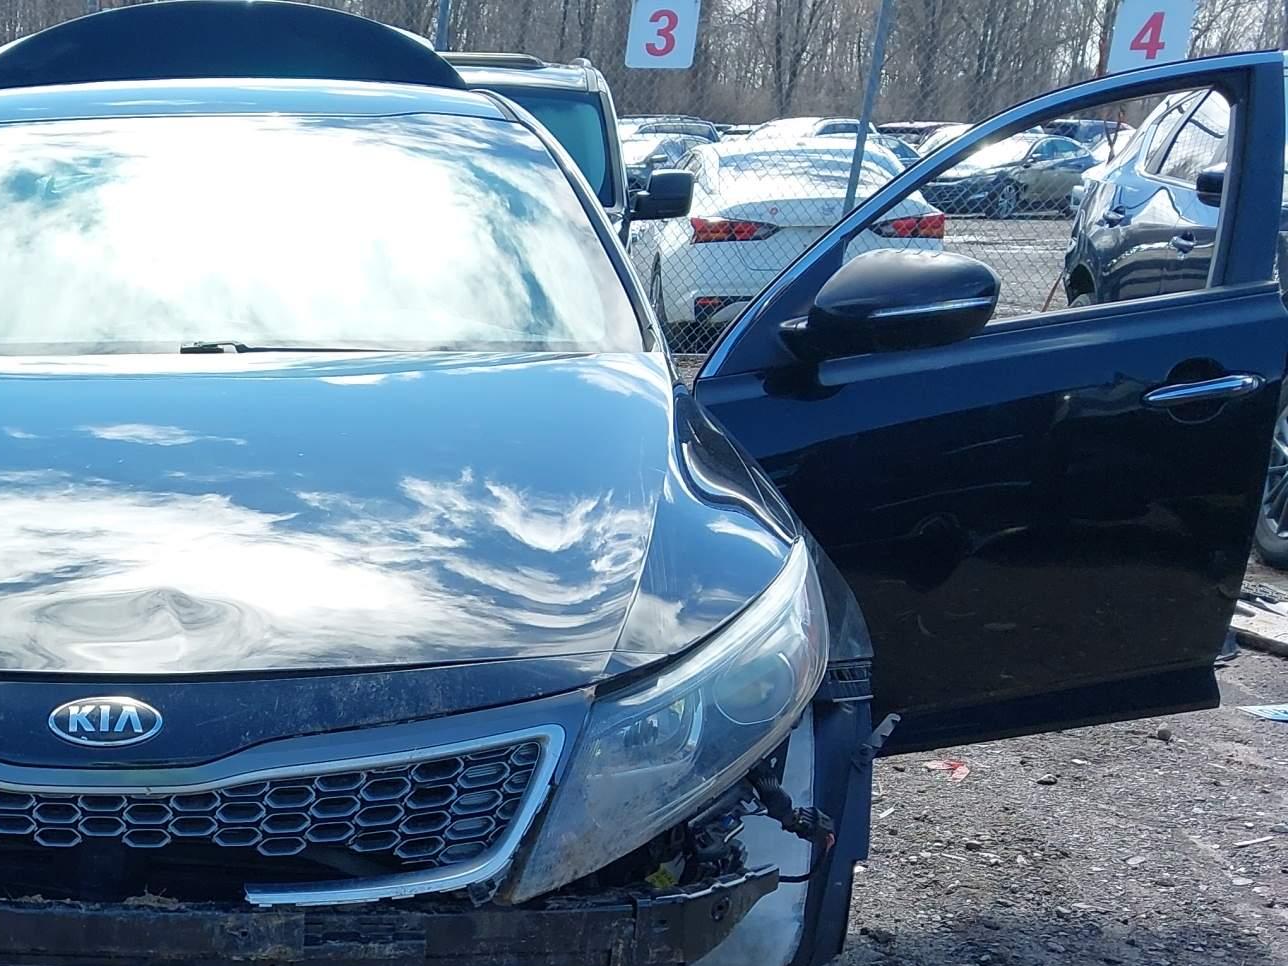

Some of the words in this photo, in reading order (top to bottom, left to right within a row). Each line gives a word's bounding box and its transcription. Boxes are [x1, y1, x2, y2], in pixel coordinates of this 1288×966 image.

[645, 9, 678, 57] 3
[1129, 11, 1166, 60] 4
[68, 704, 144, 733] KIA
